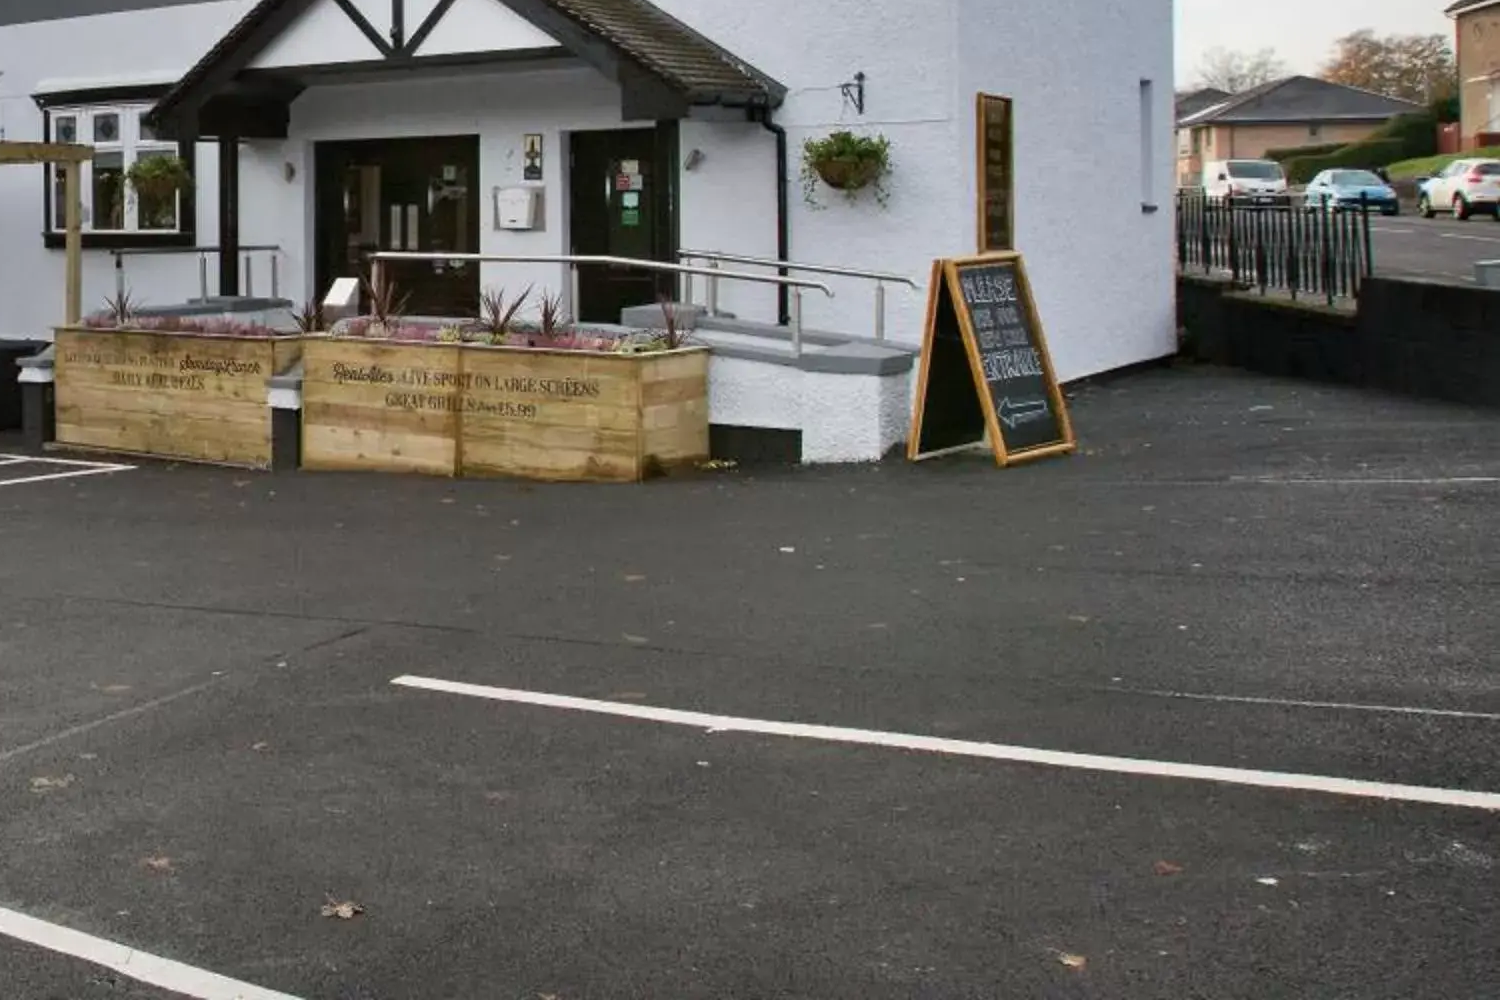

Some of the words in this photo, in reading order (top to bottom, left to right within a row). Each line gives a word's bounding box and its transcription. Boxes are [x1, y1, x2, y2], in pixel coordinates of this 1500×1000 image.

[432, 371, 471, 389] SPORT
[474, 374, 491, 389] ON
[494, 375, 537, 393] LARGE
[539, 377, 600, 398] SCREENS
[385, 391, 425, 409] GREAT
